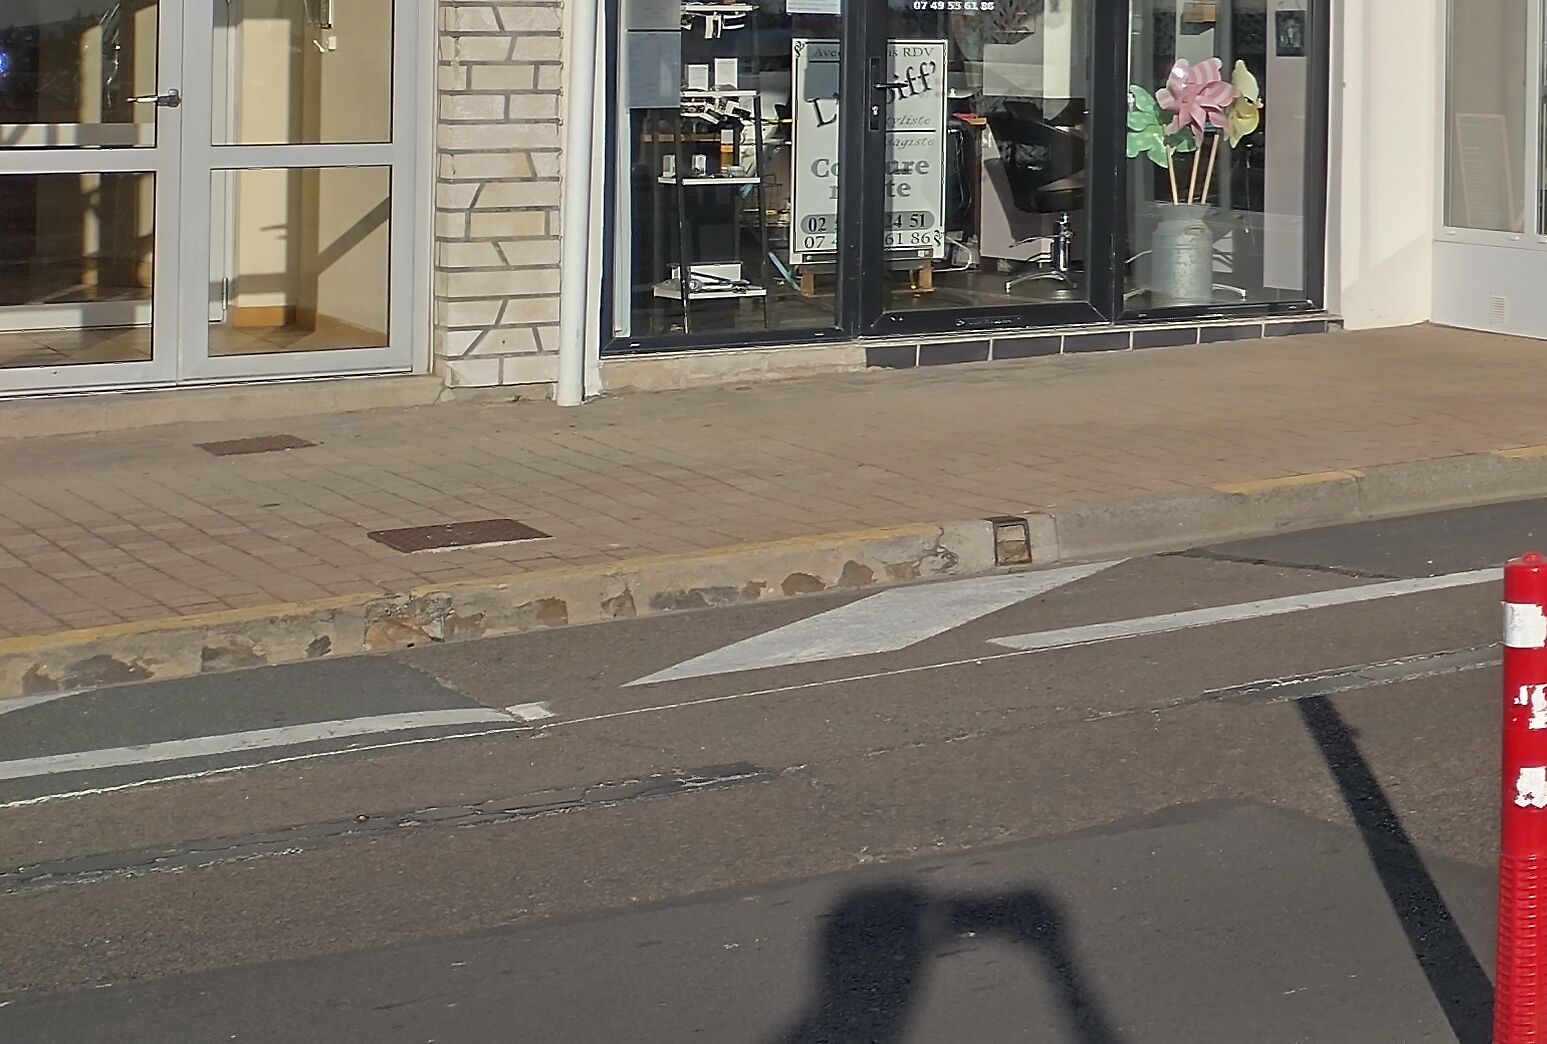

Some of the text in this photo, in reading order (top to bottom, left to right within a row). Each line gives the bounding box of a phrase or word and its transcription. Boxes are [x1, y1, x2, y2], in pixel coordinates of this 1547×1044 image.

[913, 1, 927, 11] 07
[903, 47, 935, 58] RDV
[808, 216, 827, 233] 02
[909, 213, 926, 228] 51
[804, 235, 826, 249] 07
[885, 231, 931, 246] 61 86
